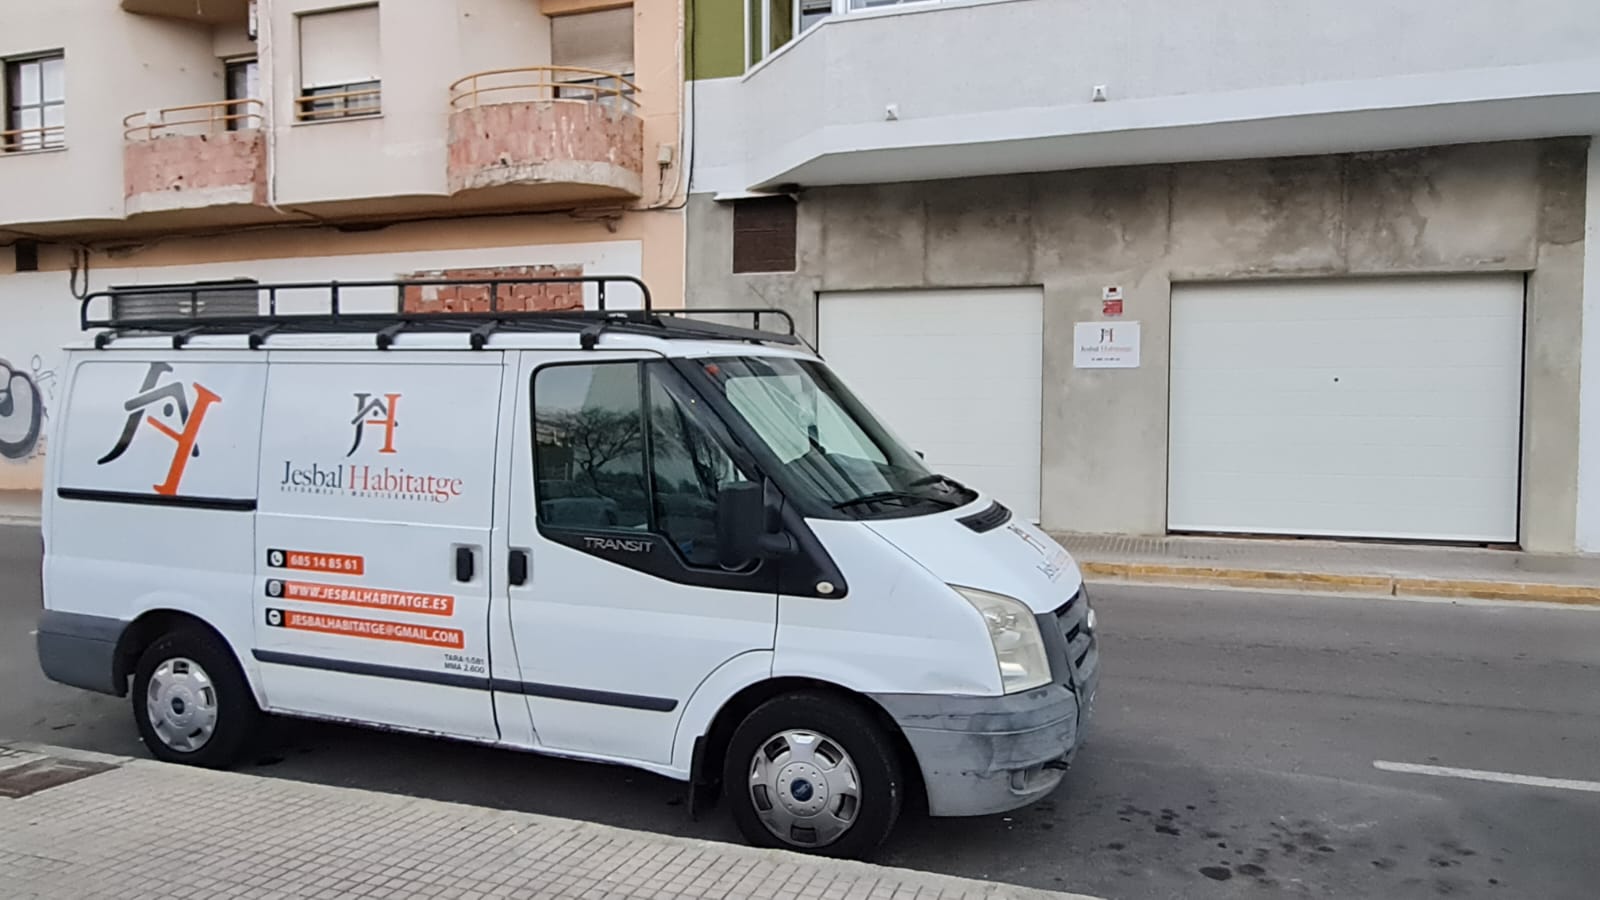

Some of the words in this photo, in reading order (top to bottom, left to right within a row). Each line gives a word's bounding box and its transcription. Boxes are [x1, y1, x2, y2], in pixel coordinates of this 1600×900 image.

[281, 461, 343, 489] Jesbal
[349, 465, 463, 503] Habitatge
[584, 537, 653, 552] TRANSIT
[290, 555, 311, 567] 685
[313, 556, 327, 567] 14
[328, 557, 342, 569] 85
[344, 559, 358, 570] 61
[288, 584, 448, 610] WWW.JESBALHABITATGE.ES
[291, 614, 459, 644] JESBALHABITATGE@GMAIL.COM
[444, 653, 463, 662] TARA
